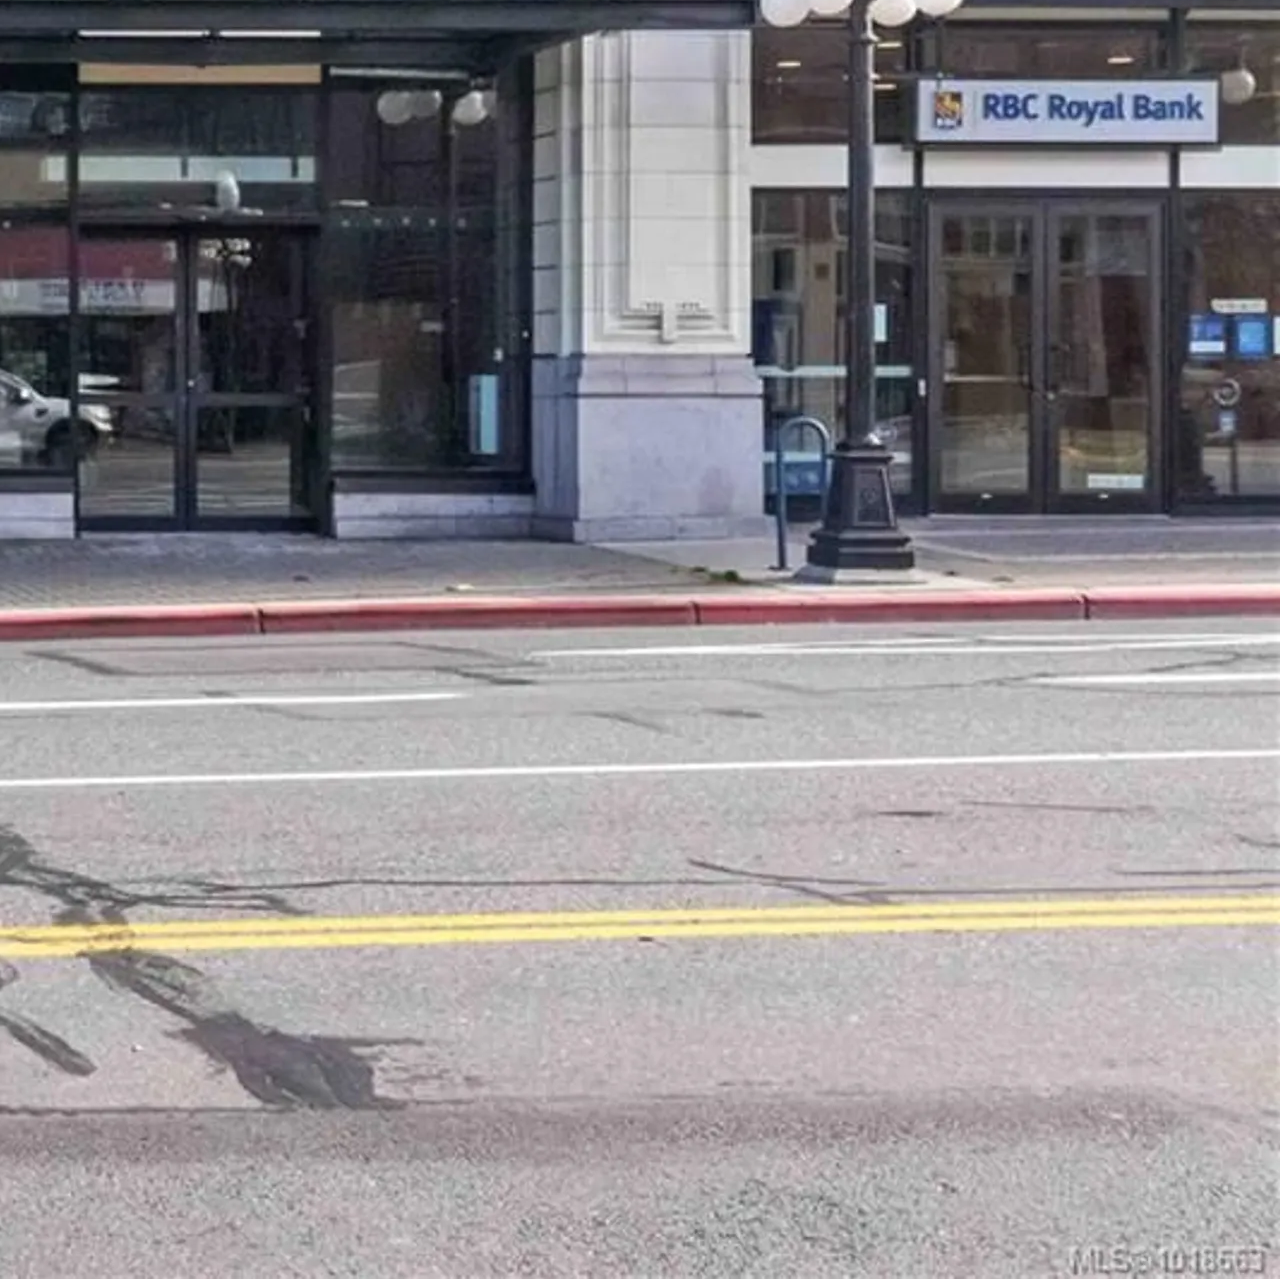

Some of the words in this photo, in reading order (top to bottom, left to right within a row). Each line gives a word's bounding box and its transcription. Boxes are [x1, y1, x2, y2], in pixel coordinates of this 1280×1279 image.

[981, 93, 1039, 120] RBC
[1047, 92, 1125, 127] Royal
[1131, 93, 1205, 120] Bank
